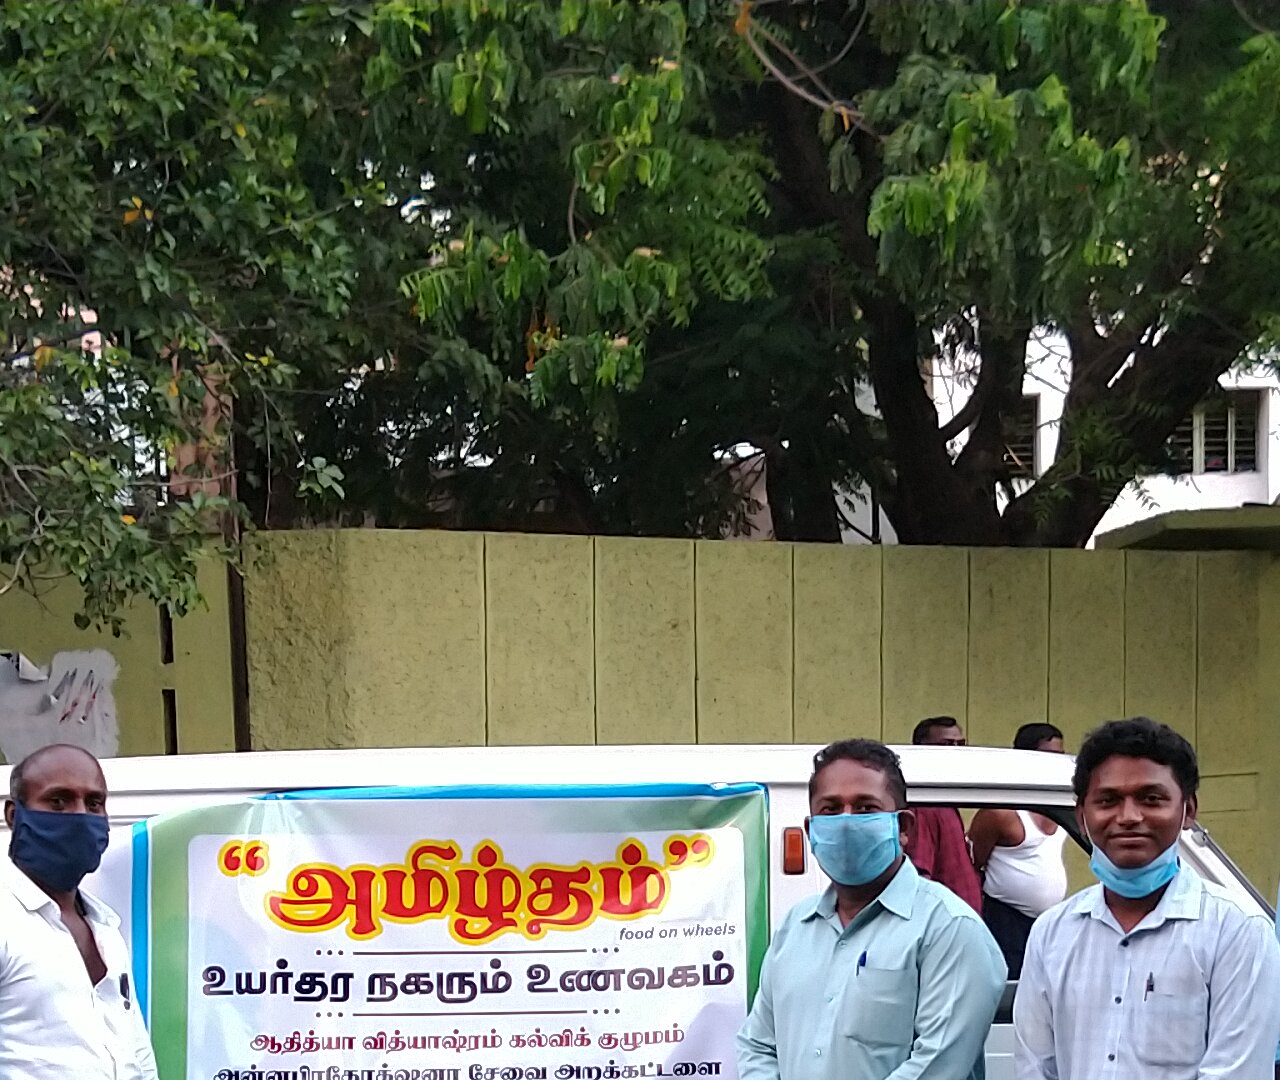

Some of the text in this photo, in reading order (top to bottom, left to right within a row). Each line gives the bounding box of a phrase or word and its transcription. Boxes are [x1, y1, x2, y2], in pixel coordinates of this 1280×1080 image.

[619, 922, 736, 940] food on wheels
[202, 950, 735, 1004] உயர்தர நகரும் உணவகம்
[249, 1029, 357, 1056] ஆதித்யா
[508, 1026, 592, 1050] கல்விக்
[597, 1023, 685, 1052] குழுமம்
